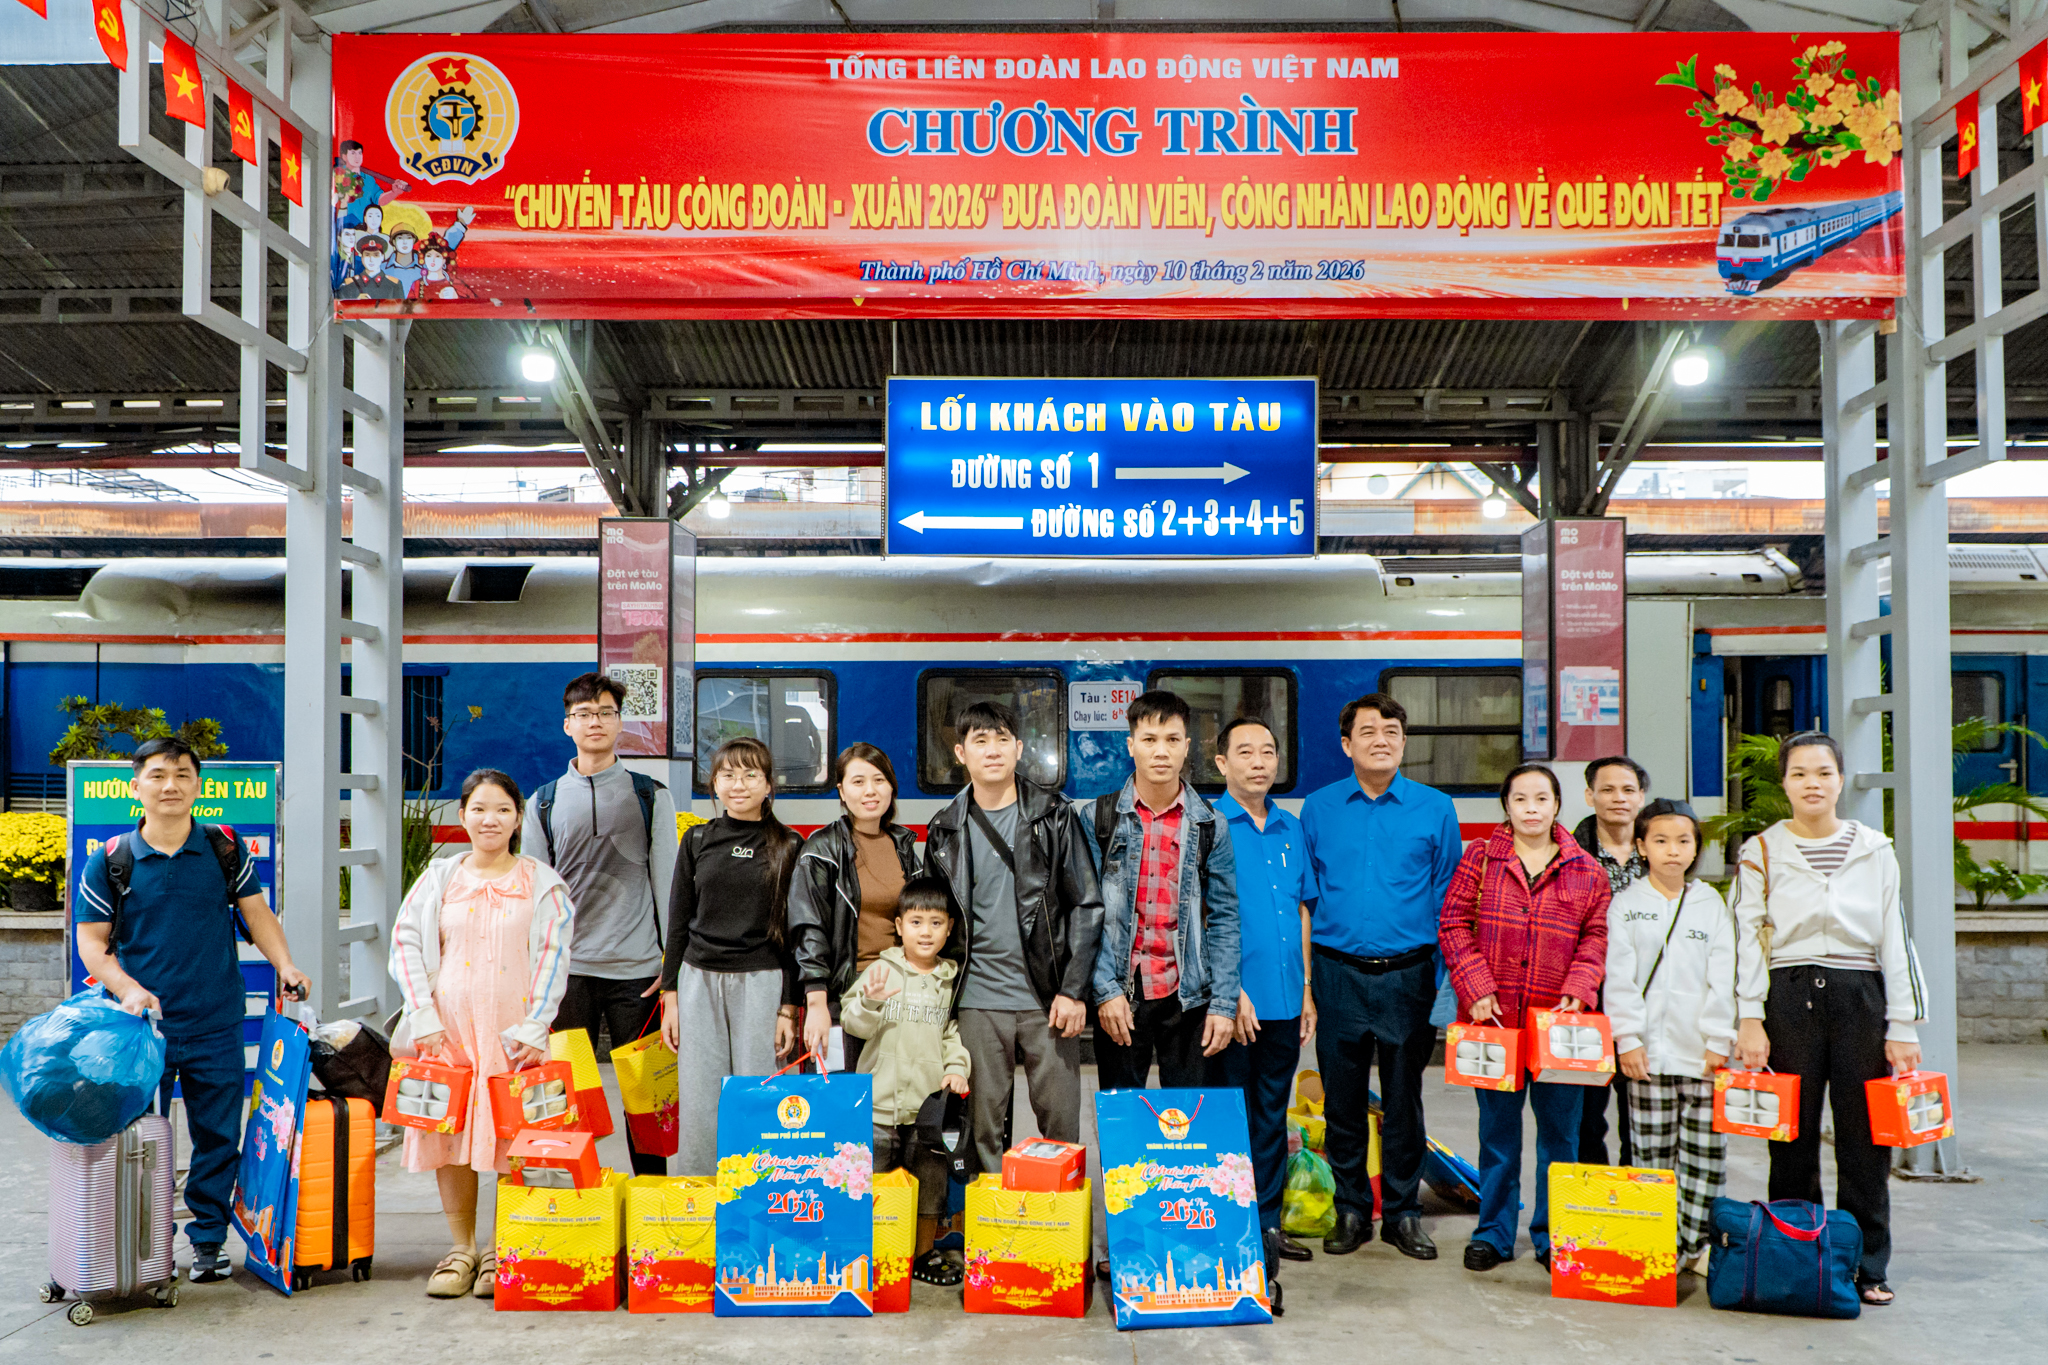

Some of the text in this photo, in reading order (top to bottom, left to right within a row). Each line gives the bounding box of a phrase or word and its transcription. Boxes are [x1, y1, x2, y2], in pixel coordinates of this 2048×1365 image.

[826, 52, 1399, 83] TỔNG LIÊN ĐOÀN LAO ĐỘNG VIỆT NAM
[867, 93, 1358, 157] CHƯƠNG TRÌNH
[430, 158, 474, 175] CĐVN
[618, 176, 671, 229] TÀU
[678, 176, 746, 229] CÔNG
[752, 176, 826, 228] ĐOÀN
[851, 176, 922, 228] XUÂN
[1002, 184, 1057, 228] ĐƯA
[1064, 176, 1139, 228] ĐOÀN
[1146, 175, 1213, 236] VIÊN,
[1221, 175, 1290, 229] CÔNG
[1297, 175, 1370, 228] NHÂN
[1376, 183, 1431, 229] LAO
[1436, 174, 1509, 236] ĐỘNG
[1515, 167, 1550, 227] VỀ
[1557, 174, 1608, 228] QUÊ
[1614, 174, 1670, 227] ĐÓN
[1676, 167, 1723, 227] TẾT
[860, 257, 1365, 285] Thành phố Hồ Chí Minh, ngày 10 tháng 2 năm 2026
[921, 394, 1281, 432] LỐI KHÁCH VÀO TÀU
[951, 451, 1099, 489] ĐƯỜNG SỐ 1
[1031, 499, 1304, 538] ĐƯỜNG SỐ 2+3+4+5
[607, 569, 658, 580] Đặt vé tàu
[607, 581, 662, 590] trên MoMo
[1584, 581, 1618, 591] MoMo
[1080, 692, 1100, 703] Tàu
[1073, 711, 1092, 723] Chạy
[83, 777, 135, 799] HƯỚN
[233, 778, 267, 799] TÀU
